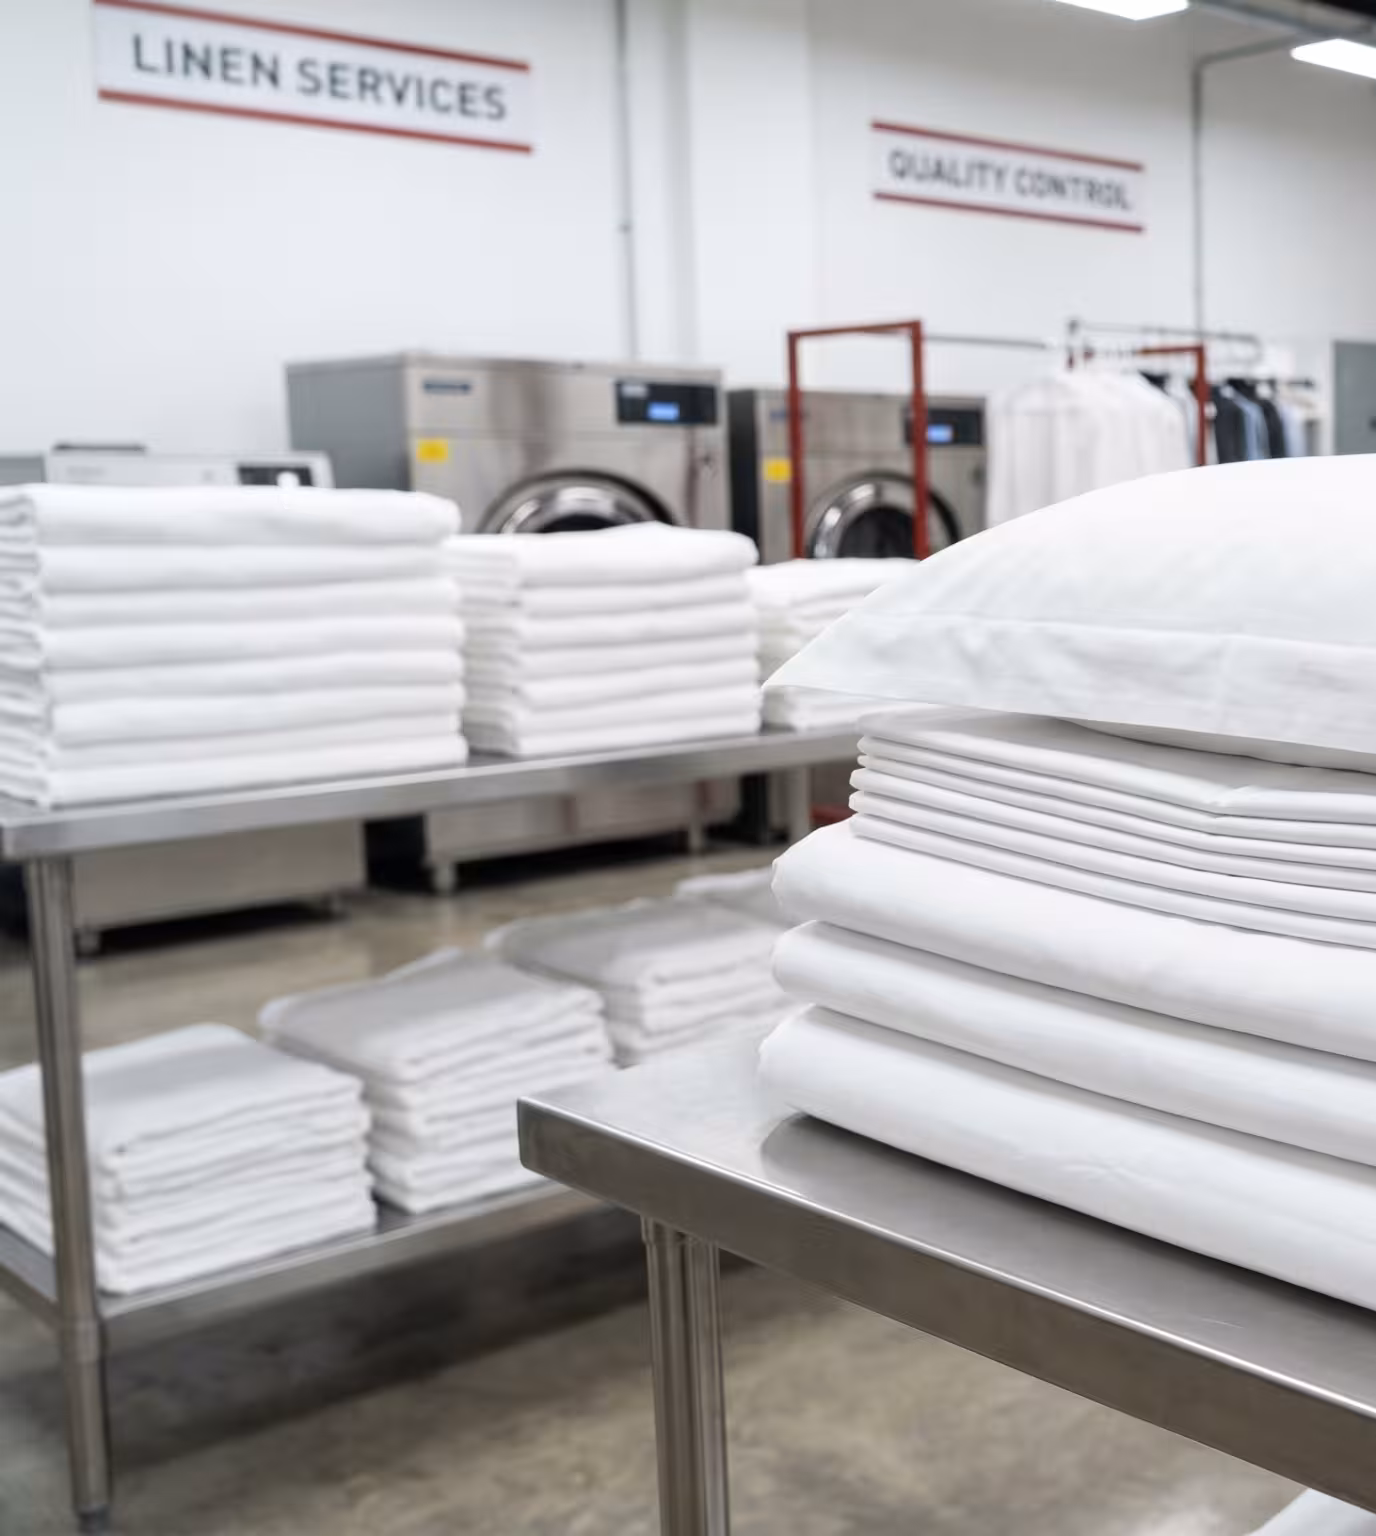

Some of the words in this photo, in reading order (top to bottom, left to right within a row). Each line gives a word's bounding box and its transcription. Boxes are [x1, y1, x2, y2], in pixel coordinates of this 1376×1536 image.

[132, 34, 280, 89] LINEN
[298, 59, 507, 121] SERVICES
[888, 149, 1008, 190] QUALITY
[1013, 167, 1132, 211] CONTROL
